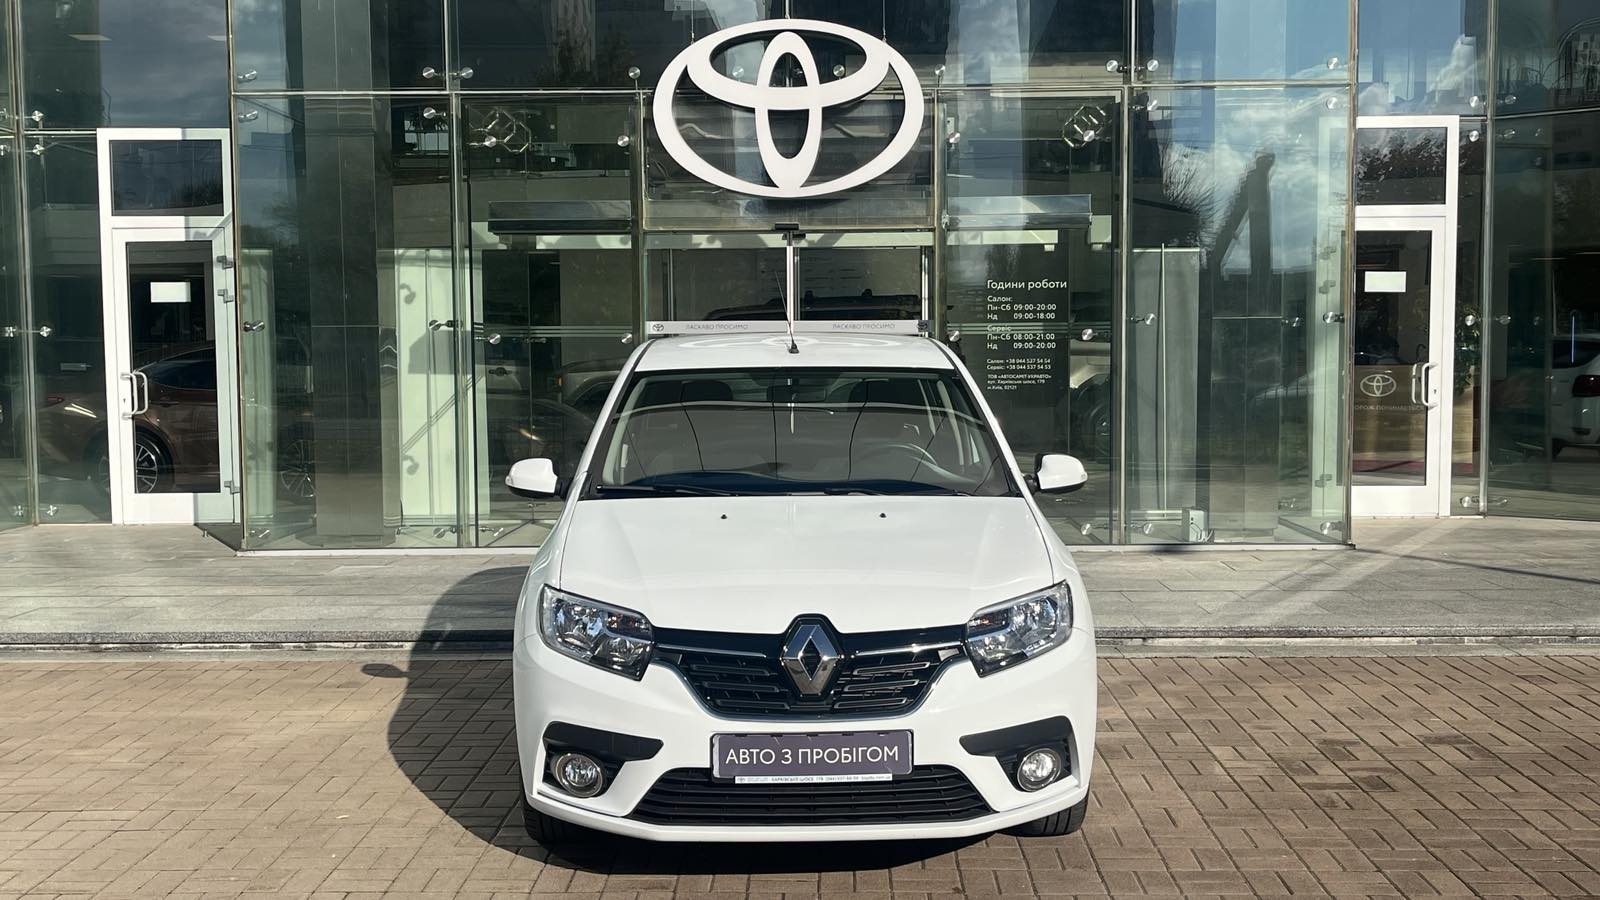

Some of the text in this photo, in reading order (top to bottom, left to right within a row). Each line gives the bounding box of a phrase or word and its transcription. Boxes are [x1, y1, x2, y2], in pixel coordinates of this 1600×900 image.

[987, 279, 1067, 291] Години роботи
[987, 342, 998, 350] Нд
[725, 745, 899, 765] АВТО З ПРОБІГОМ
